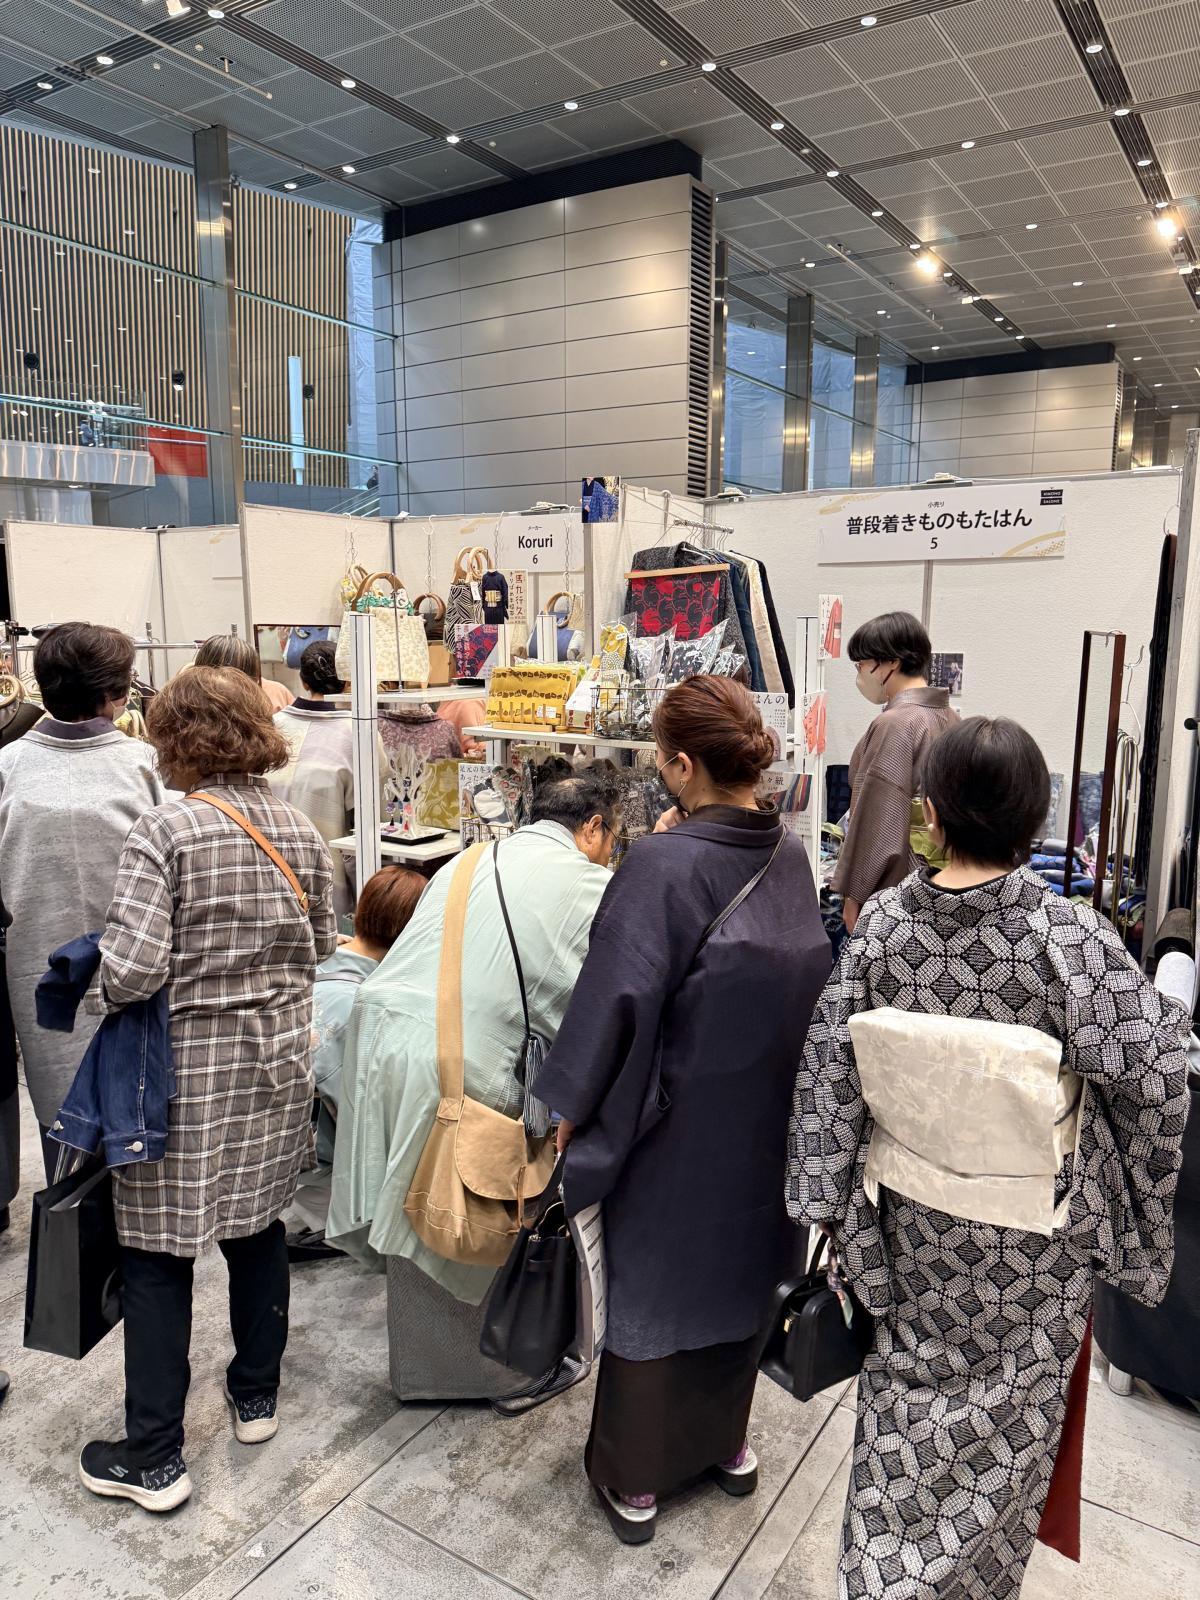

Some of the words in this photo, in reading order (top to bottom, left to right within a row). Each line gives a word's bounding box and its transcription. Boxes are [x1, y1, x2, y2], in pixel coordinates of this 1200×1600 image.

[927, 501, 945, 509] 小売り
[846, 508, 1033, 536] 普段着きものもたはん
[518, 534, 553, 548] Koruri
[930, 537, 938, 550] 5
[532, 554, 539, 565] 6
